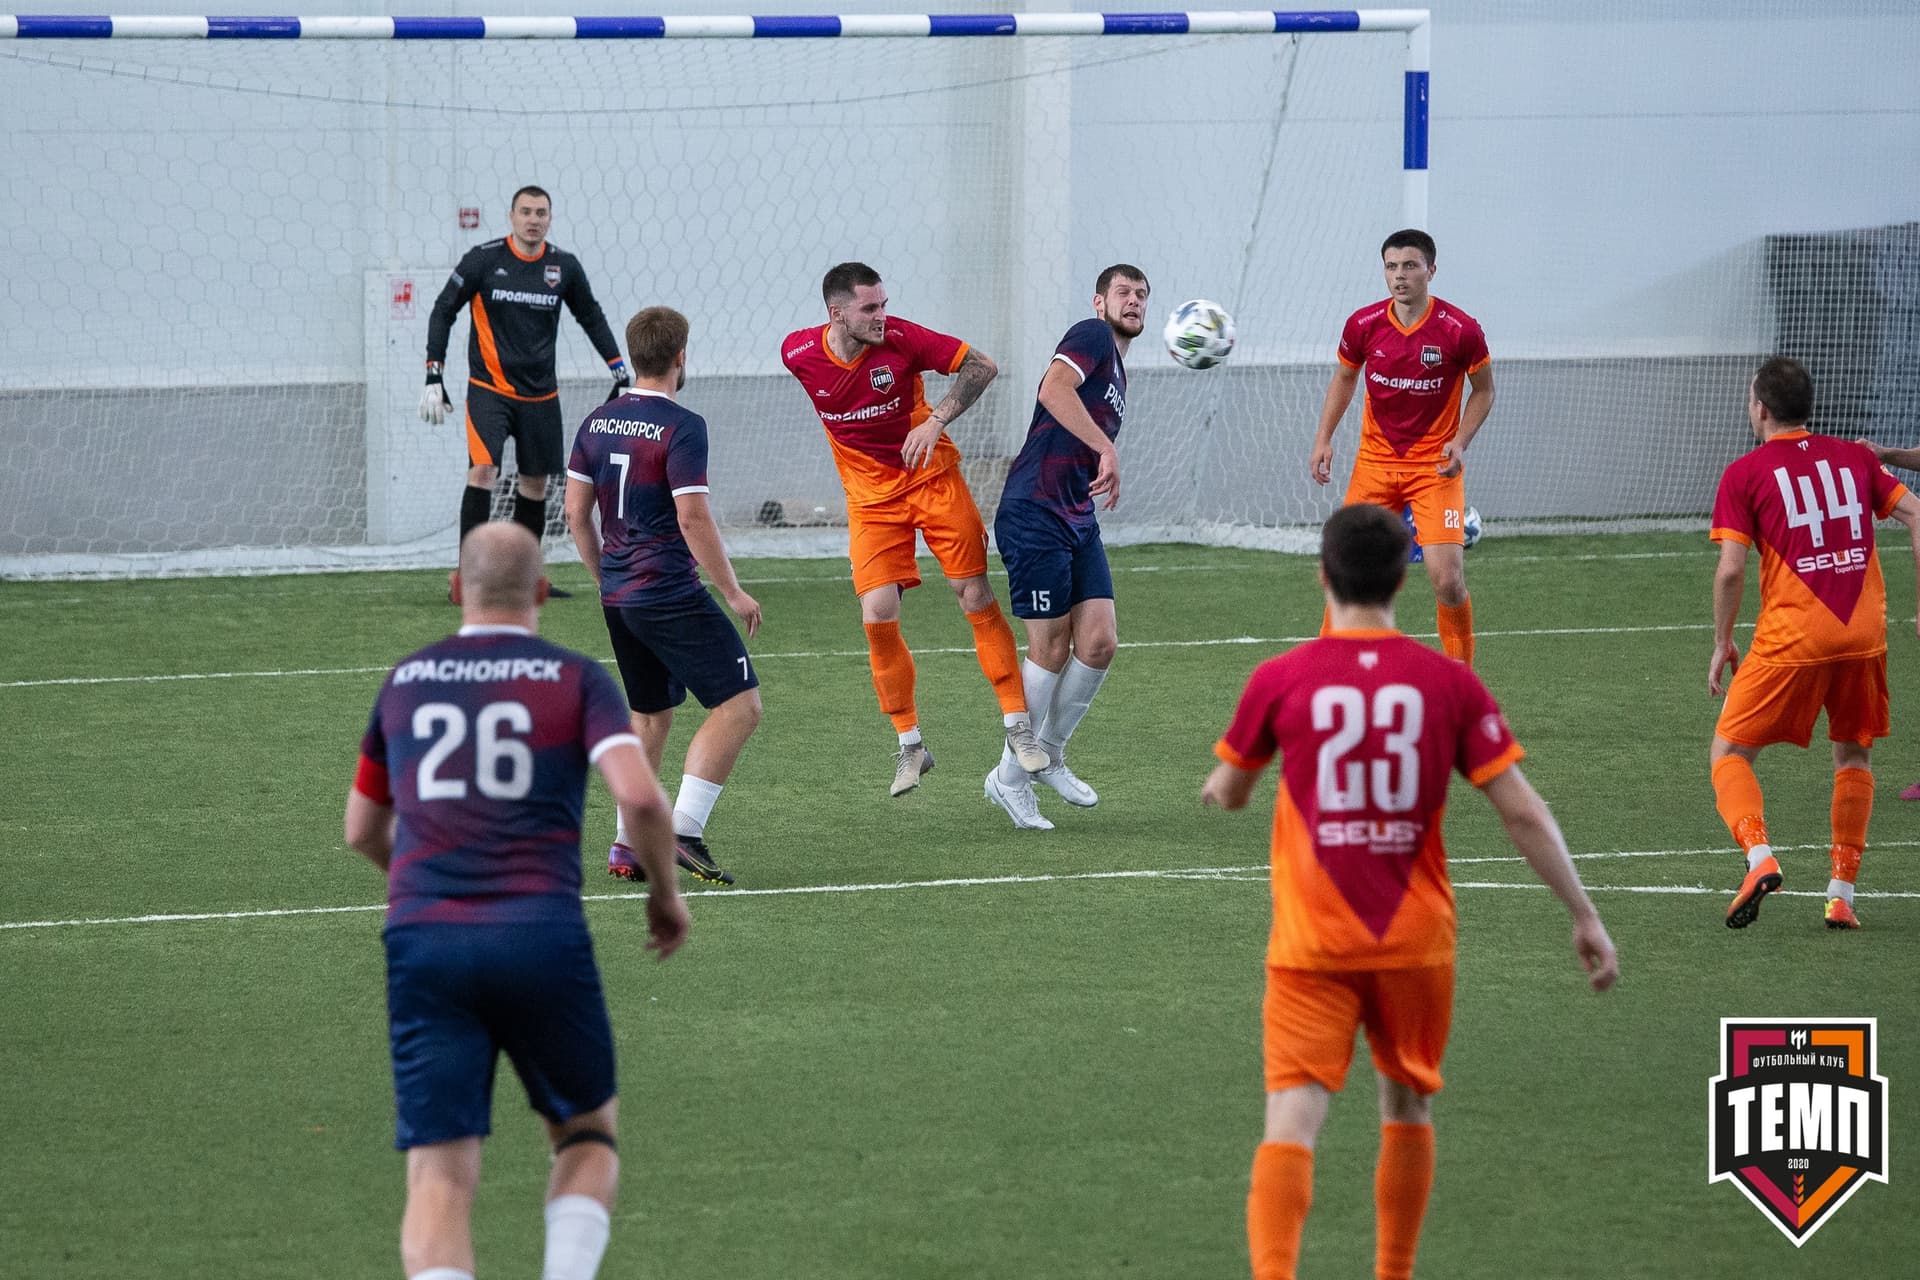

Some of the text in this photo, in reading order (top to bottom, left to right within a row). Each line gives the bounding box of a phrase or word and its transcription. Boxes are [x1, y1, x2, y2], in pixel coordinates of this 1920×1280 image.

[1369, 372, 1443, 390] ПРОДИНВЕСТ
[1104, 383, 1126, 421] РАСС
[589, 418, 665, 441] КРАСНОЯРСК
[609, 452, 630, 519] 7
[1773, 459, 1863, 548] 44
[1444, 509, 1460, 529] 22
[1796, 547, 1866, 573] SEUS
[1031, 590, 1051, 612] 15
[392, 658, 563, 686] КРАСНОЯРСК
[737, 656, 748, 680] 7
[411, 700, 534, 801] 26
[1310, 684, 1425, 814] 23
[1317, 820, 1416, 847] SEUS
